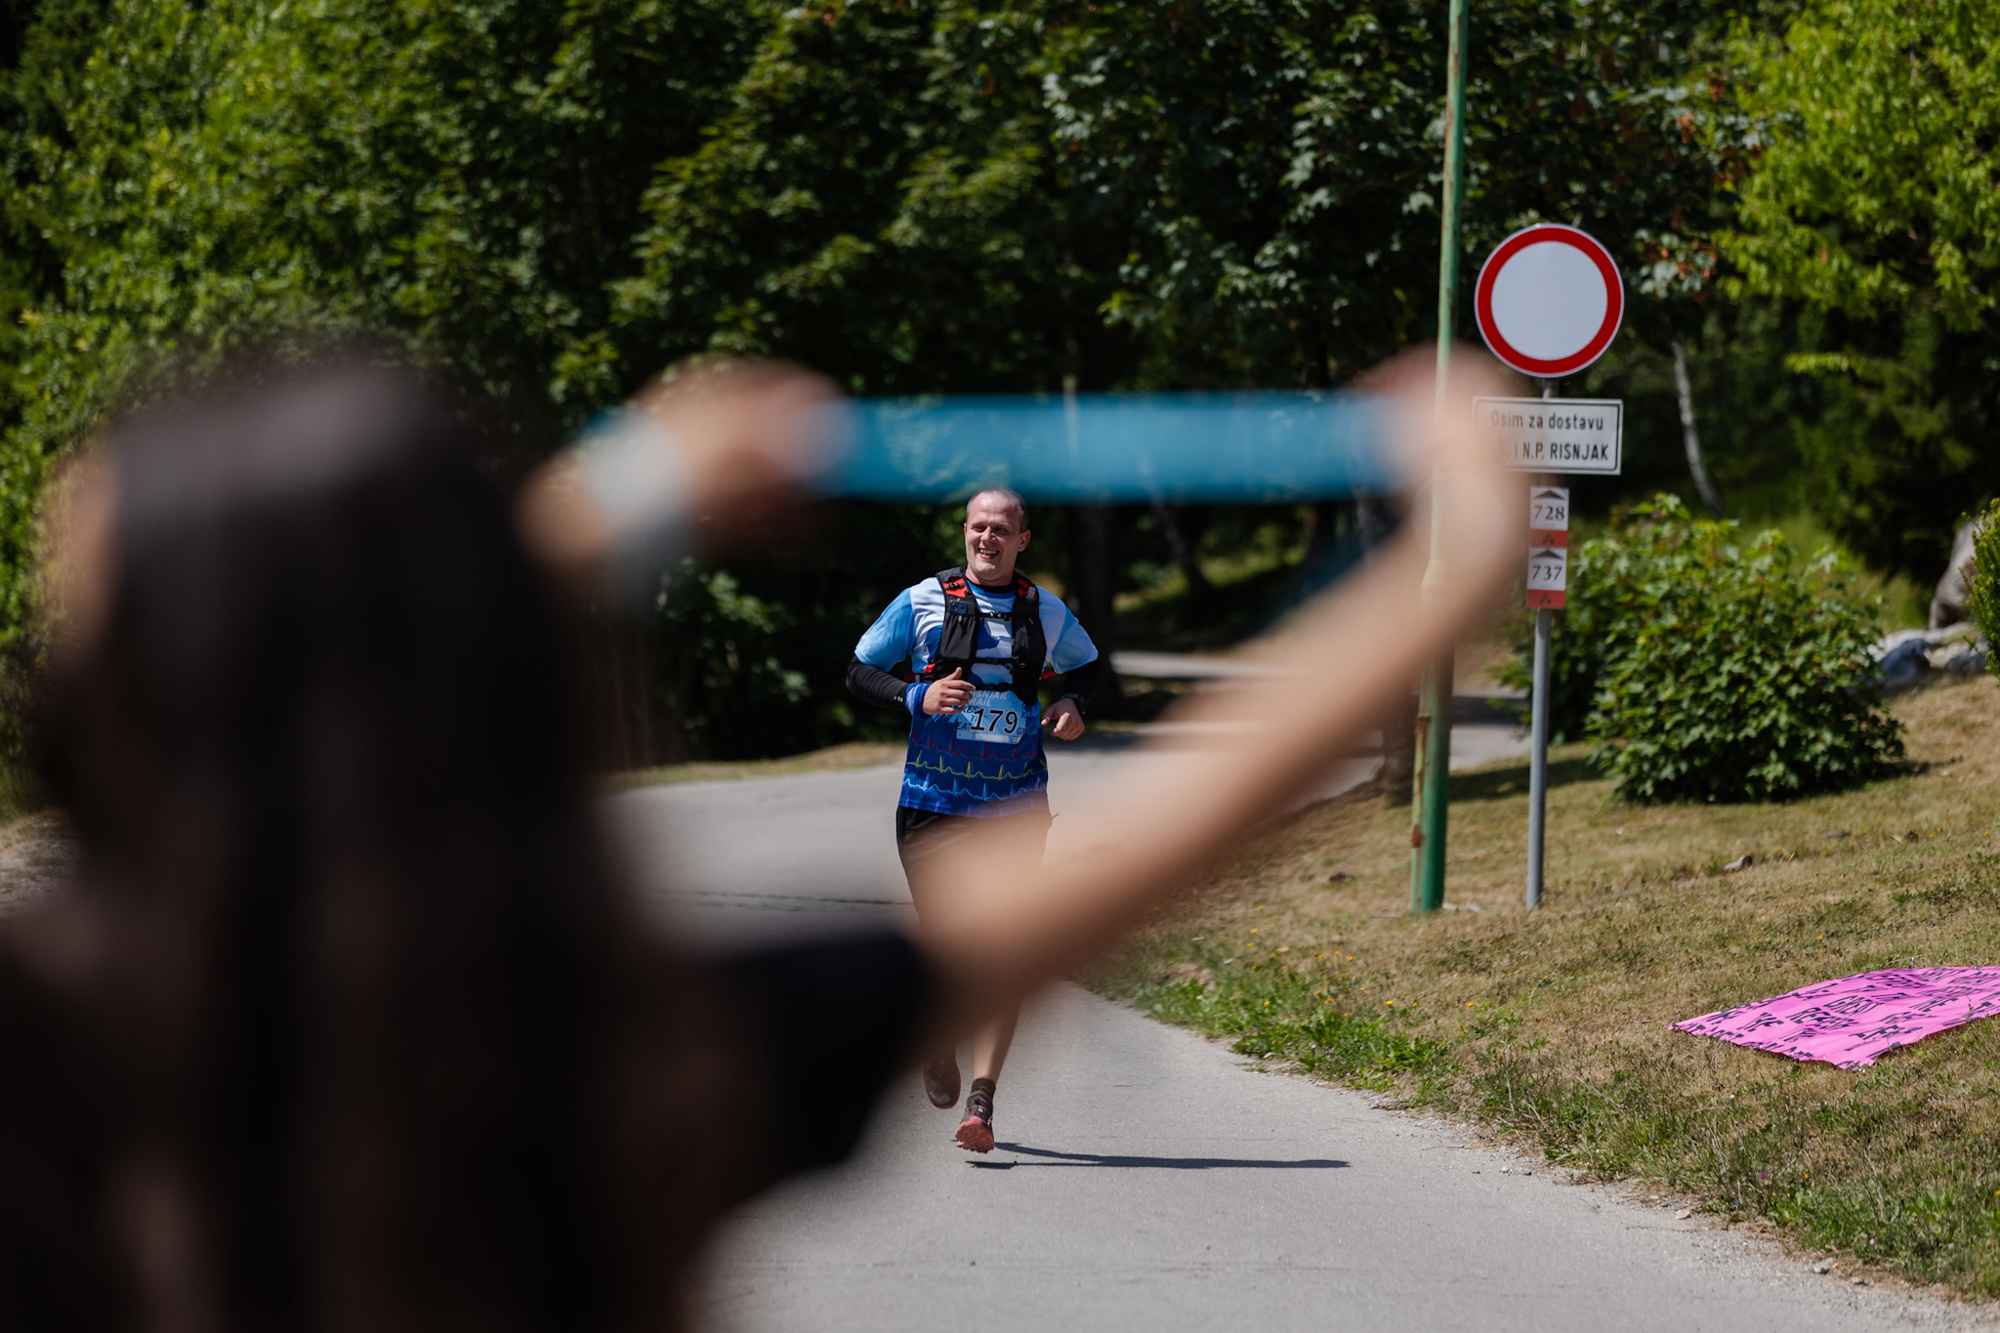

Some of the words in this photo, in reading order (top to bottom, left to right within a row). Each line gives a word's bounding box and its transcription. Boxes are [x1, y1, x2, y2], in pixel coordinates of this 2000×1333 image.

[1491, 410, 1524, 429] Osim
[1528, 415, 1544, 429] za
[1548, 412, 1604, 431] dostavu
[1522, 441, 1545, 460] N.P.
[1549, 442, 1609, 461] RISNJAK
[1534, 505, 1565, 521] 728
[1532, 565, 1562, 581] 737
[968, 698, 991, 707] RAIL
[972, 690, 1007, 700] ISNJAK
[970, 708, 1018, 734] 179
